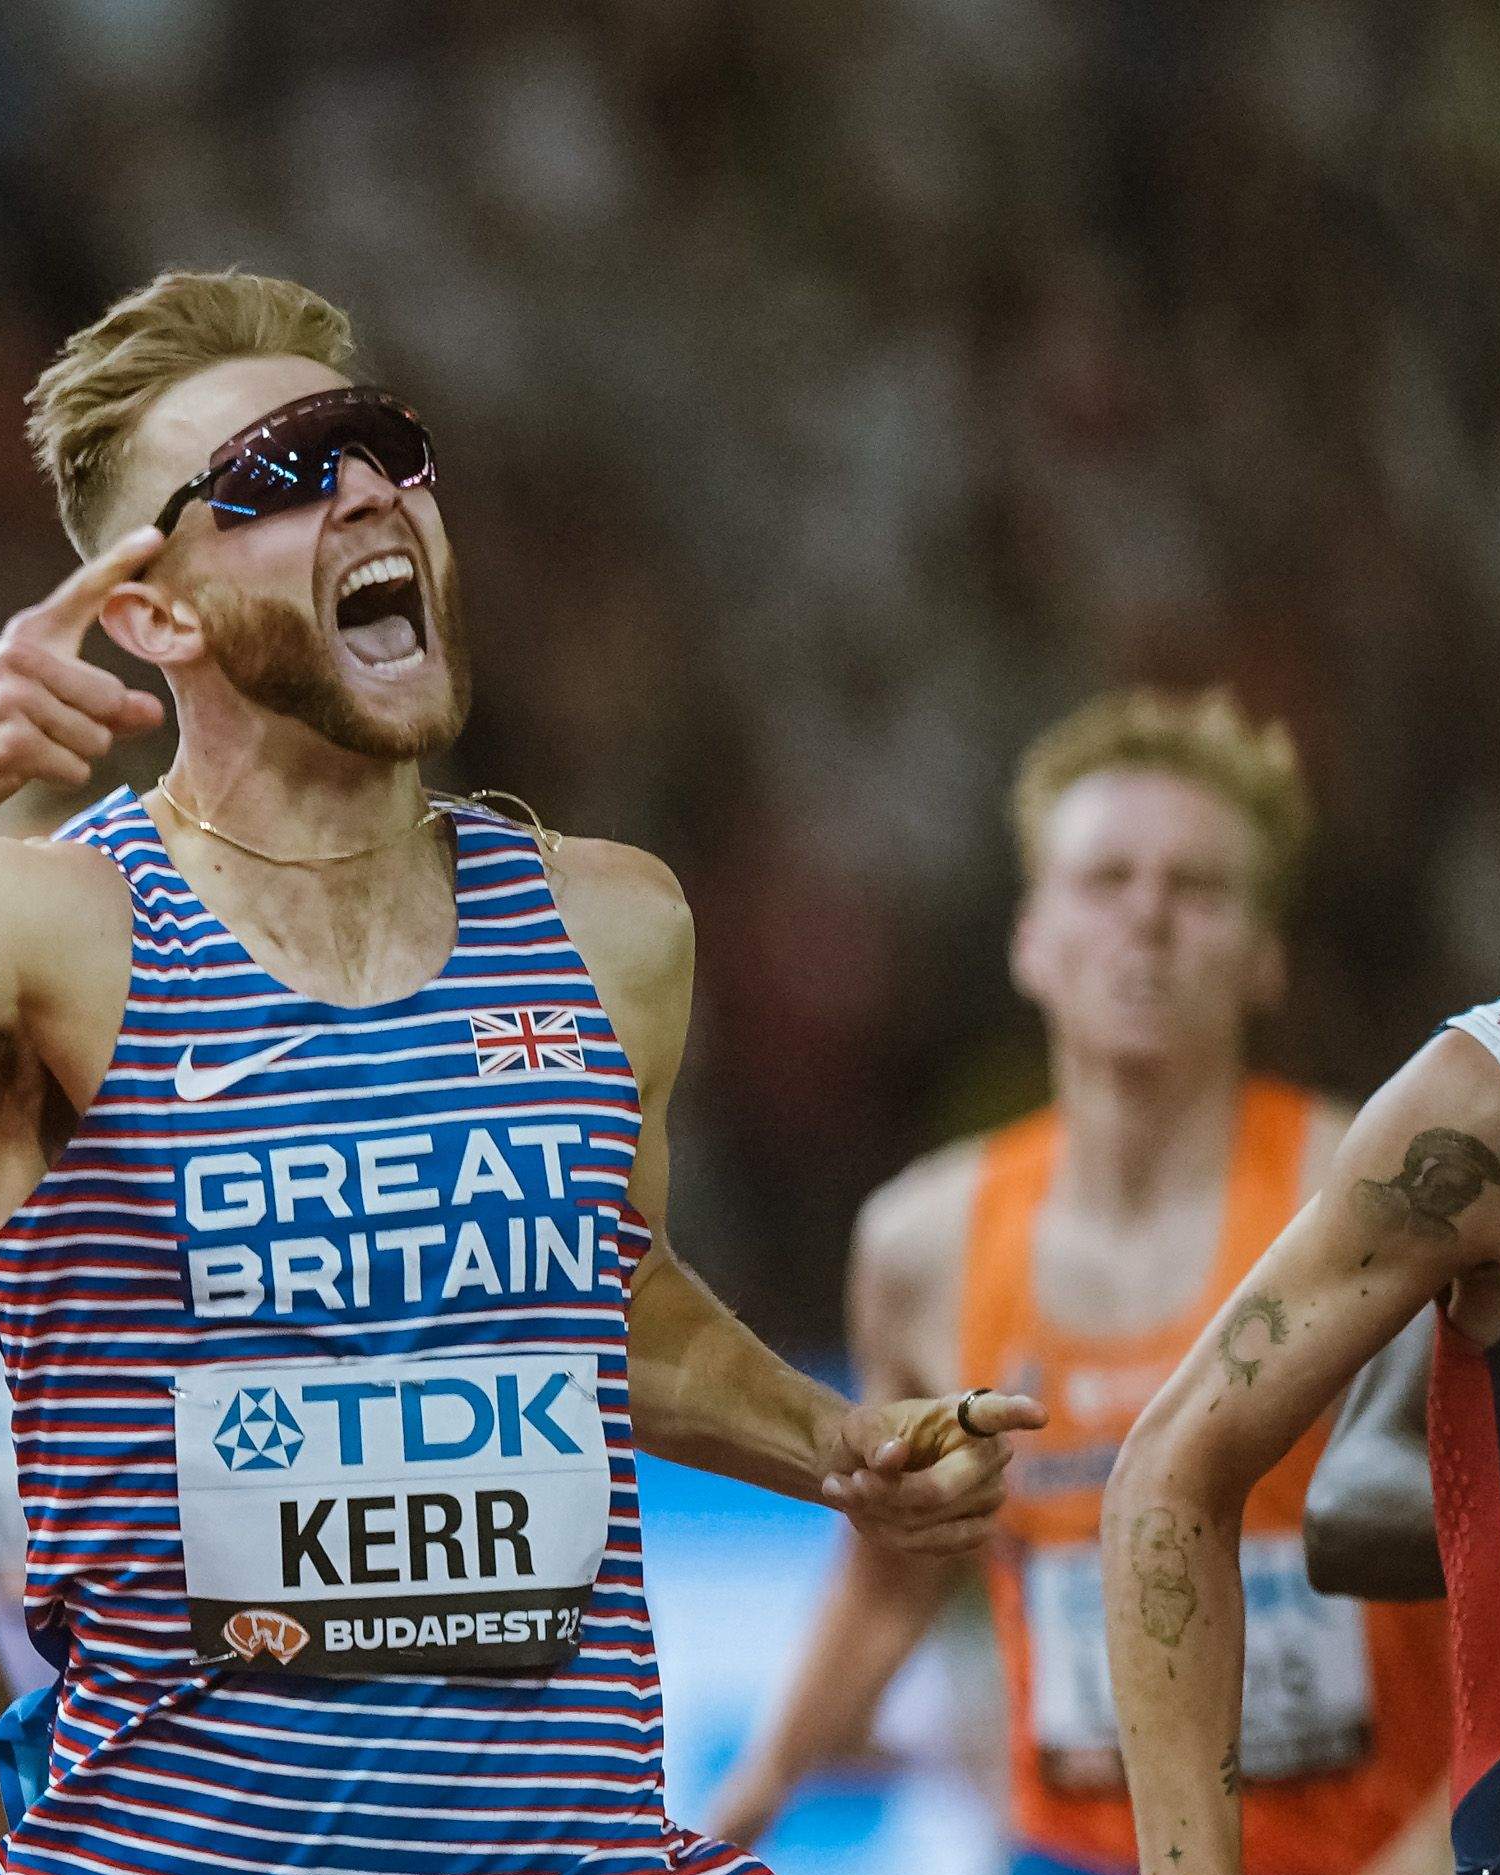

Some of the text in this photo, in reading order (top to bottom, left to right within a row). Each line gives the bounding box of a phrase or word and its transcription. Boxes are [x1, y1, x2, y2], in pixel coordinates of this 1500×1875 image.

[184, 1123, 584, 1232] GREAT
[188, 1215, 594, 1319] BRITAIN
[302, 1372, 583, 1466] TDK
[279, 1488, 536, 1590] KERR
[324, 1608, 552, 1652] BUDAPEST
